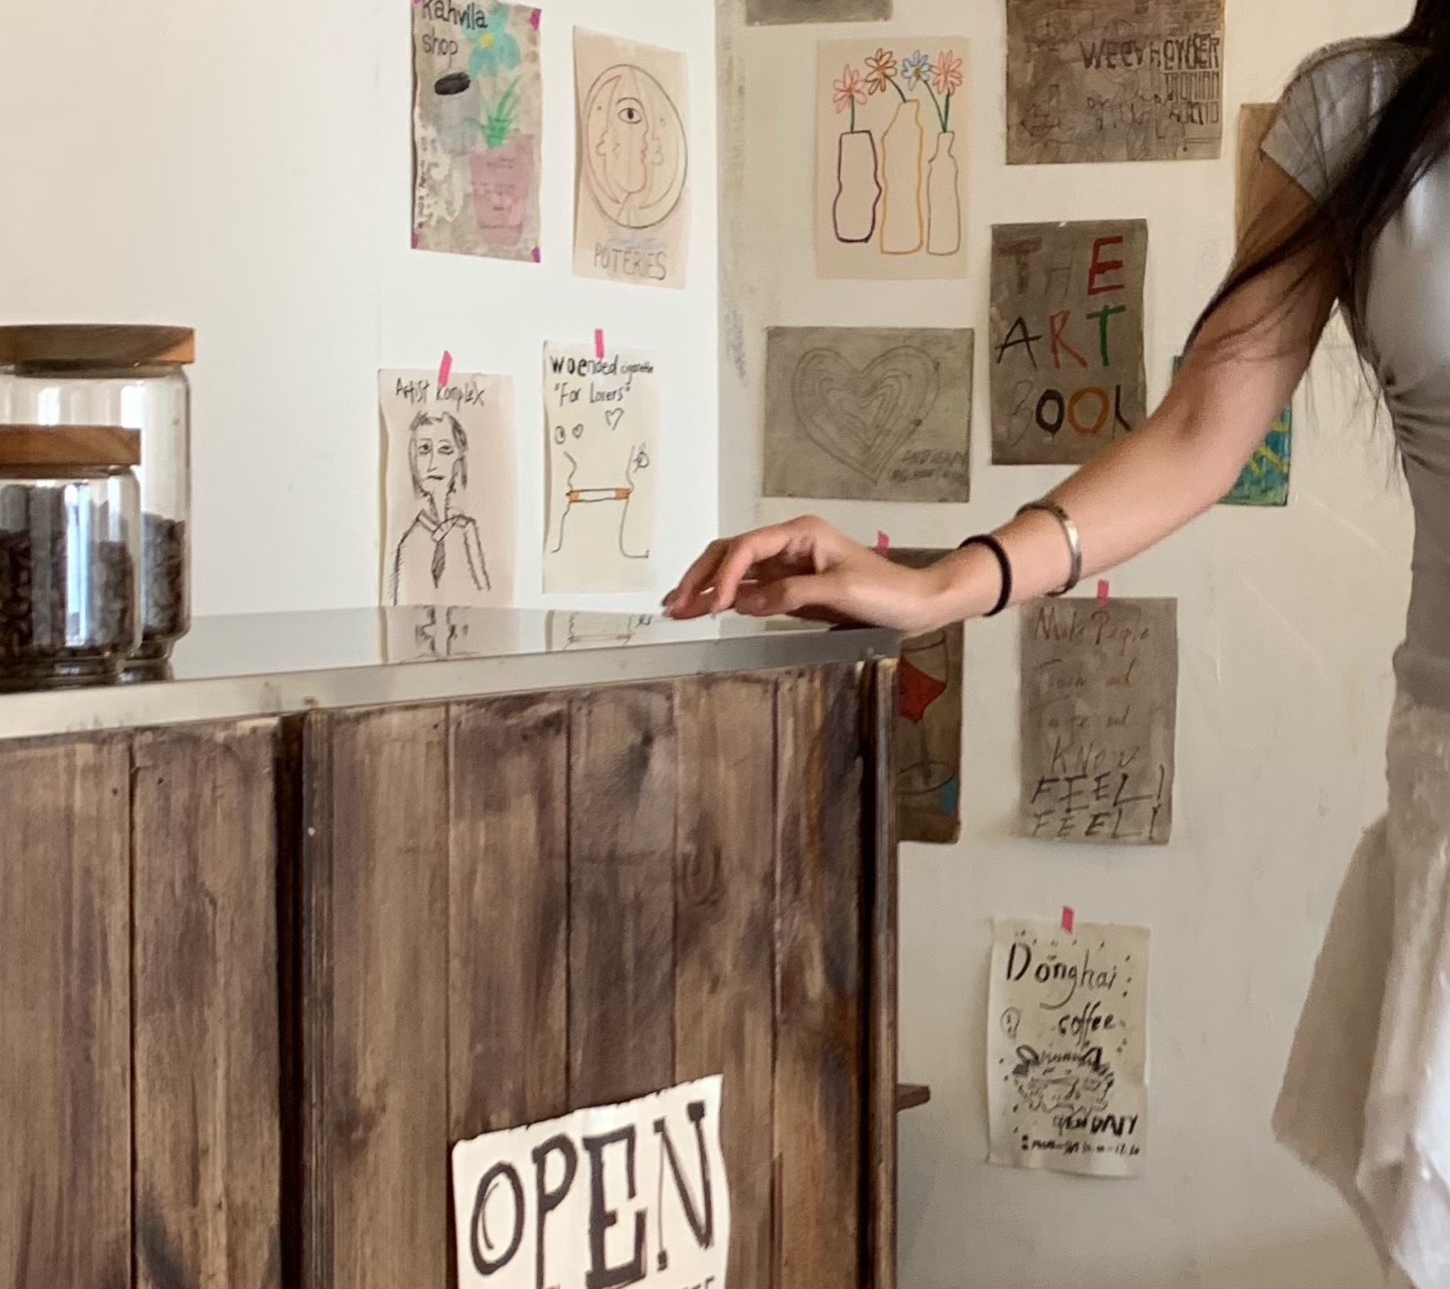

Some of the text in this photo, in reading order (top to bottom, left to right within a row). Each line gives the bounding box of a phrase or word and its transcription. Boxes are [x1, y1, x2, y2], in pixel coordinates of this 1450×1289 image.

[422, 28, 458, 70] shop
[999, 235, 1126, 296] THE
[995, 305, 1126, 371] ART
[1003, 380, 1133, 450] BOOK
